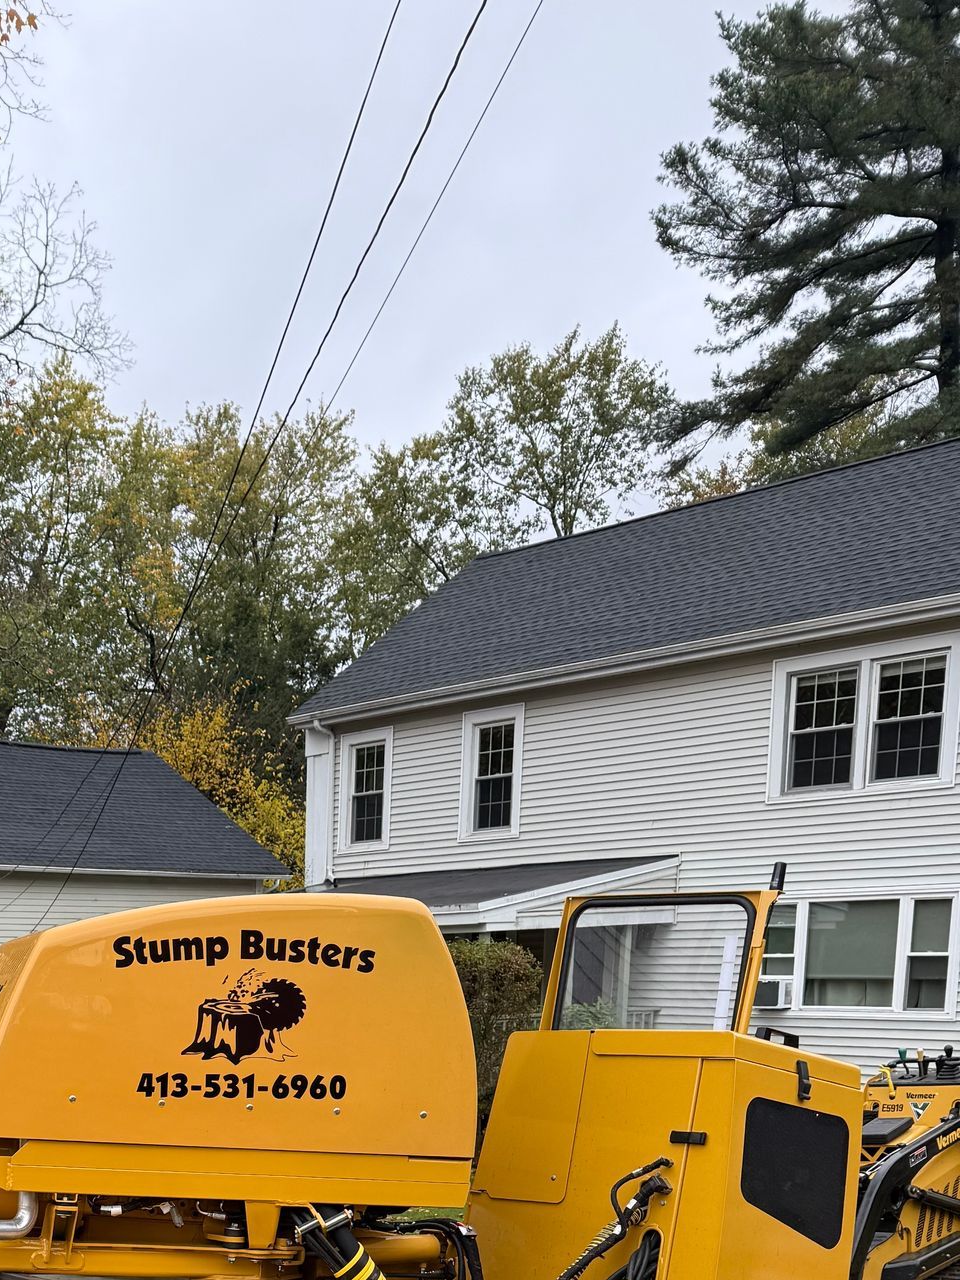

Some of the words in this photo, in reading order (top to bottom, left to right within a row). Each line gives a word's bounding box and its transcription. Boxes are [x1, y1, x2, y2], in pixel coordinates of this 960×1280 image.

[113, 934, 229, 968] Stump
[241, 929, 376, 974] Busters
[136, 1072, 347, 1100] 413-531-6960
[881, 1103, 904, 1113] E5919
